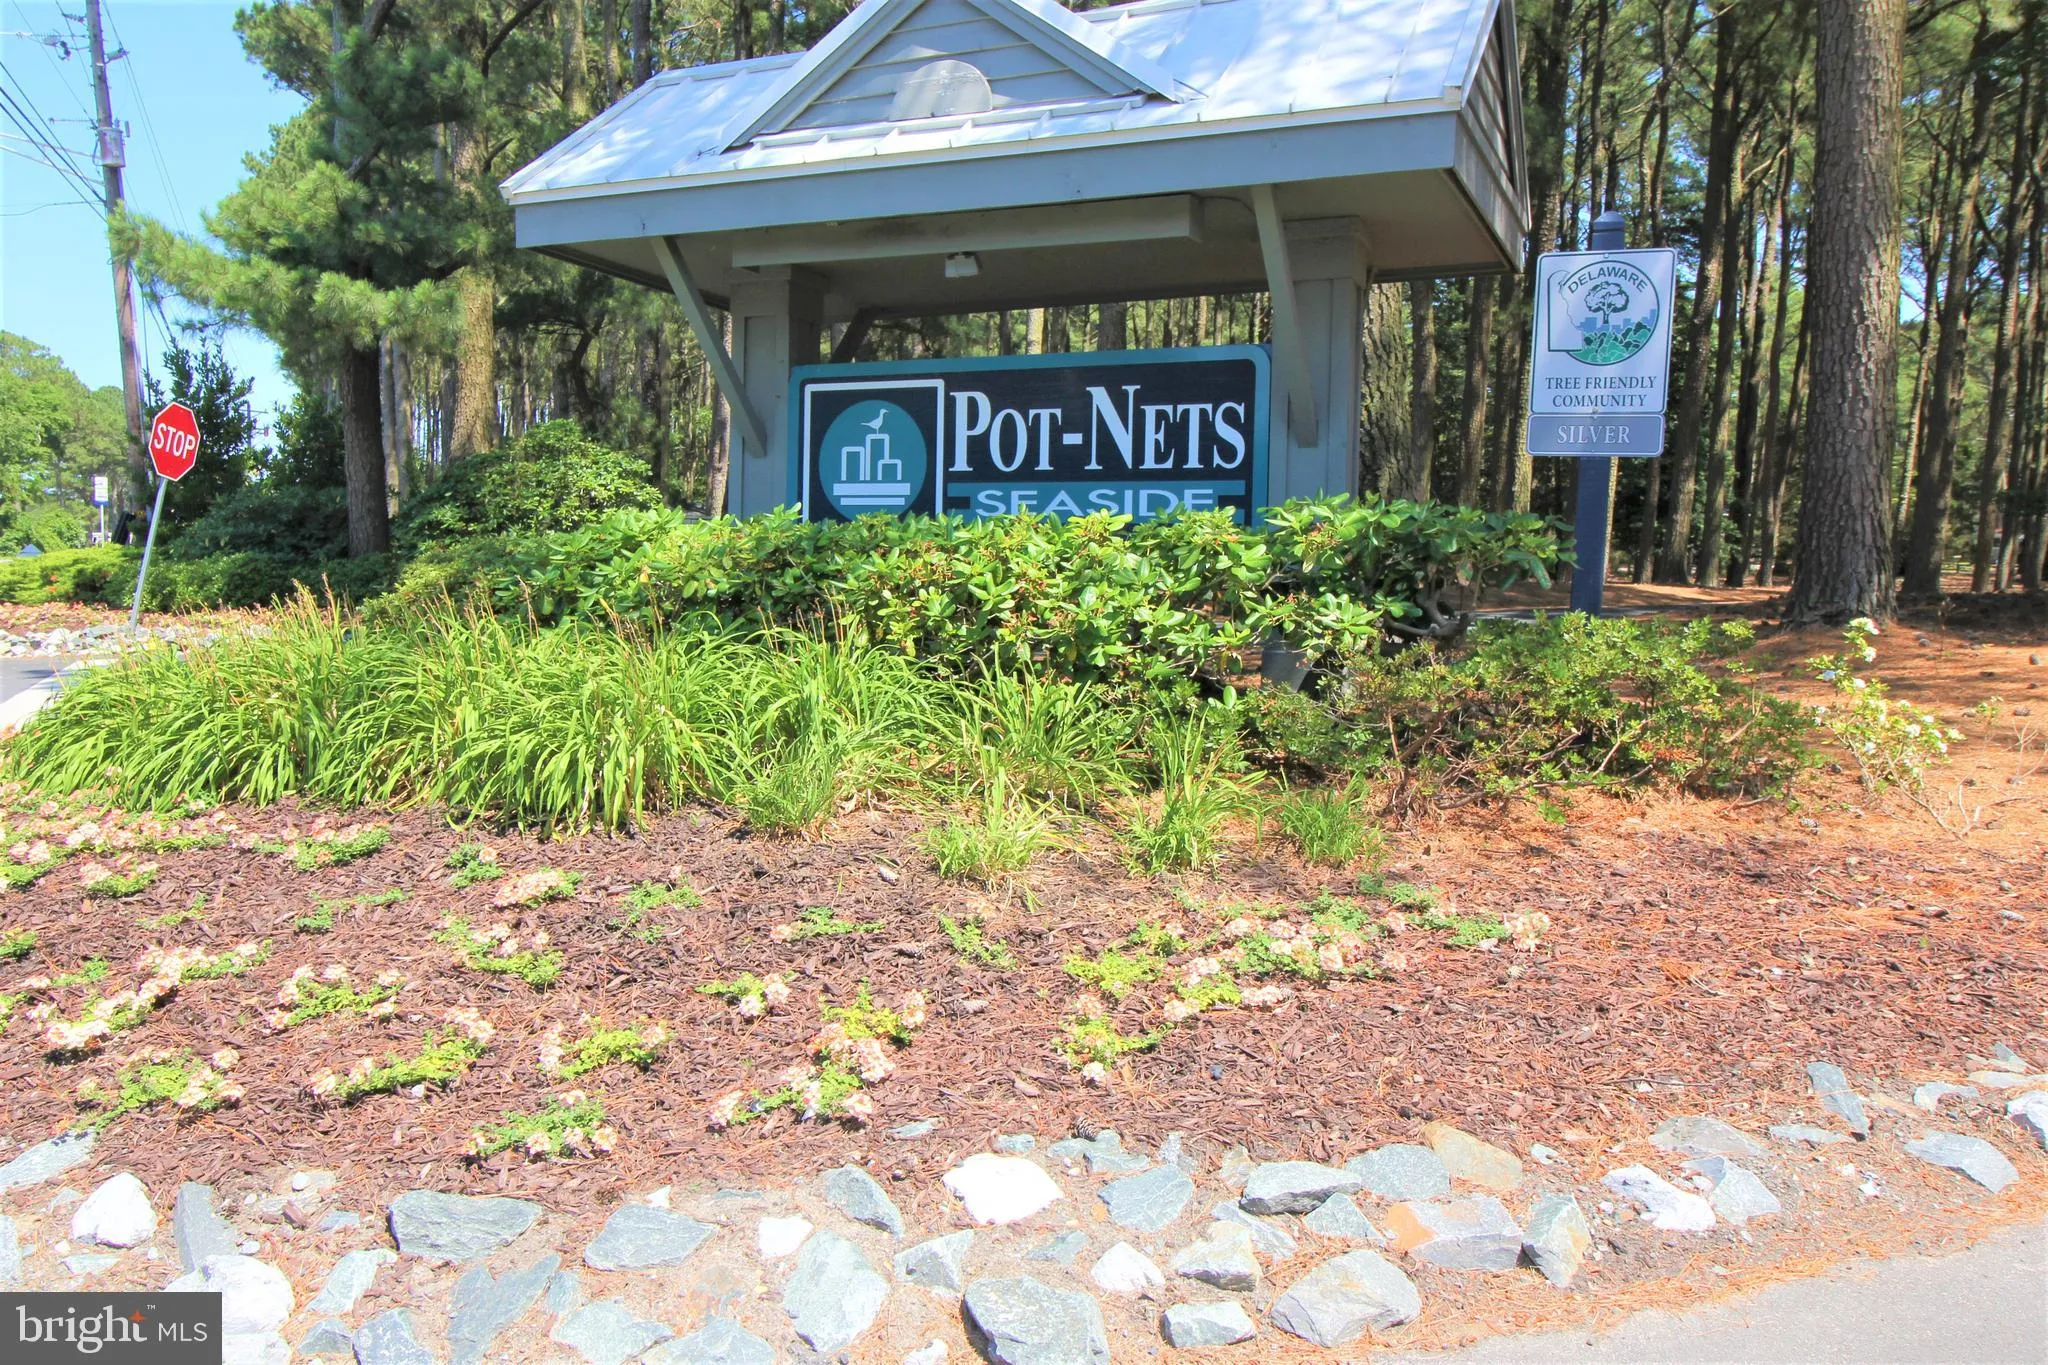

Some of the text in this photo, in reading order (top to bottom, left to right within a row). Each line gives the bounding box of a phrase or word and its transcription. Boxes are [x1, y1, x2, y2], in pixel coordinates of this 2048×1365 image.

[1568, 267, 1648, 293] DELAWARE
[1545, 376, 1657, 390] TREE FRIENDLY
[1552, 395, 1646, 407] COMMUNITY
[154, 423, 195, 459] STOP
[1557, 425, 1630, 444] SILVER
[976, 489, 1213, 517] SEASIDE
